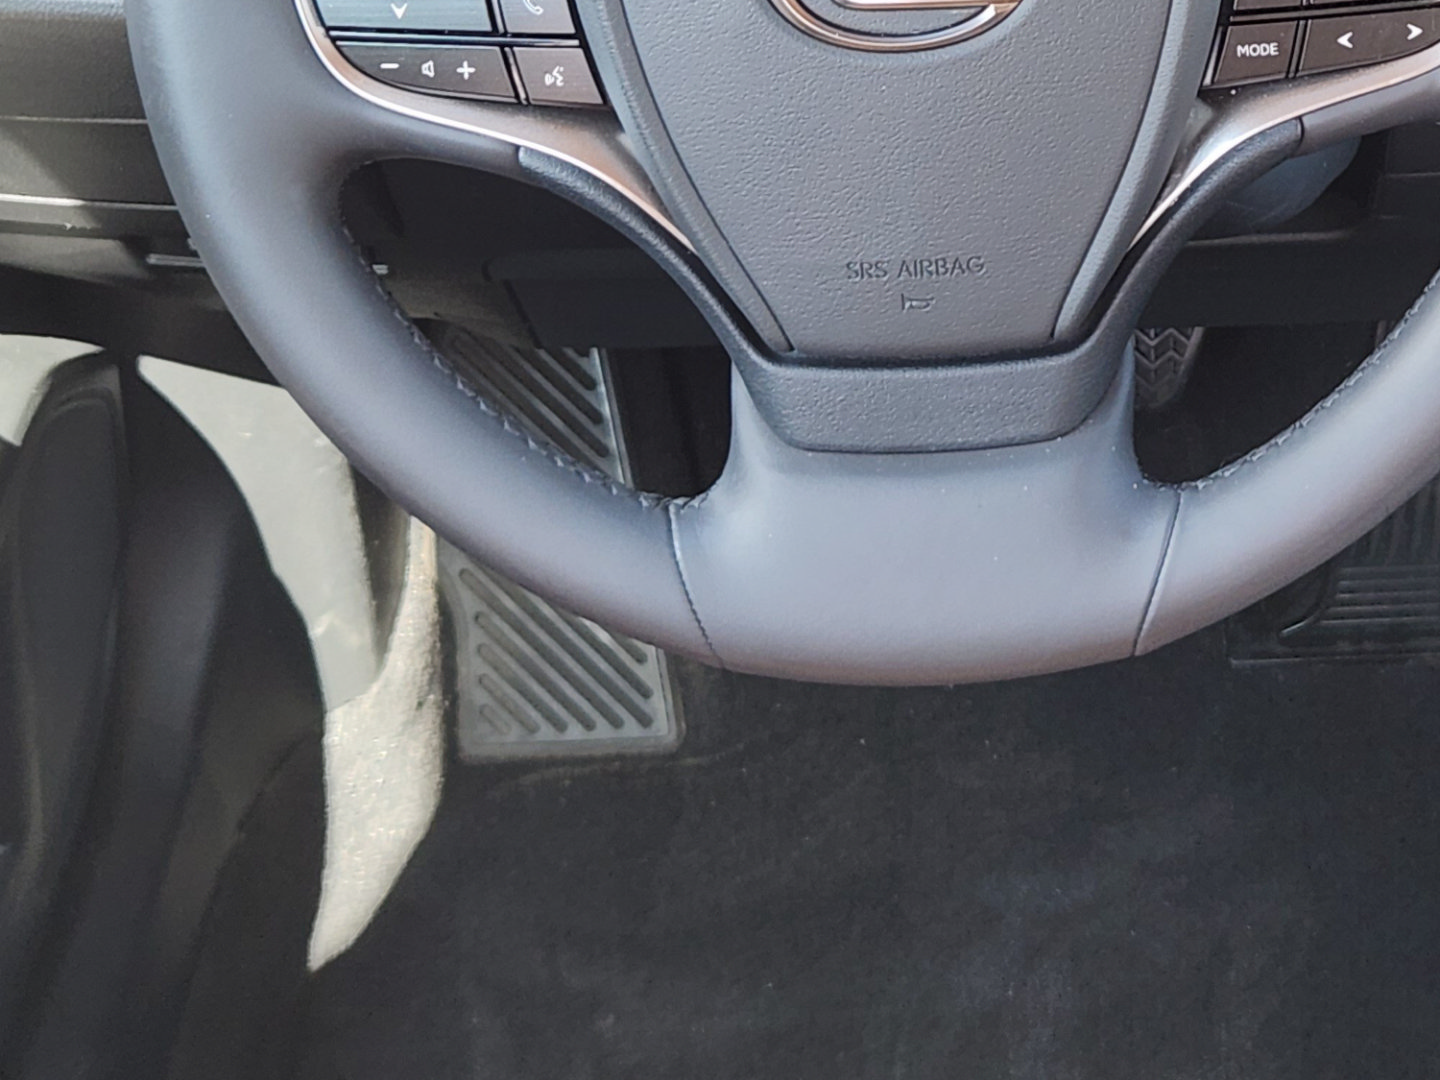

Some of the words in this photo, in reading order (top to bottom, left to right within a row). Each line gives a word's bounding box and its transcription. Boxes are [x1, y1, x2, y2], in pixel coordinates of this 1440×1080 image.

[1237, 43, 1279, 57] MODE
[846, 260, 889, 280] SRS
[898, 256, 985, 278] AIRBAG
